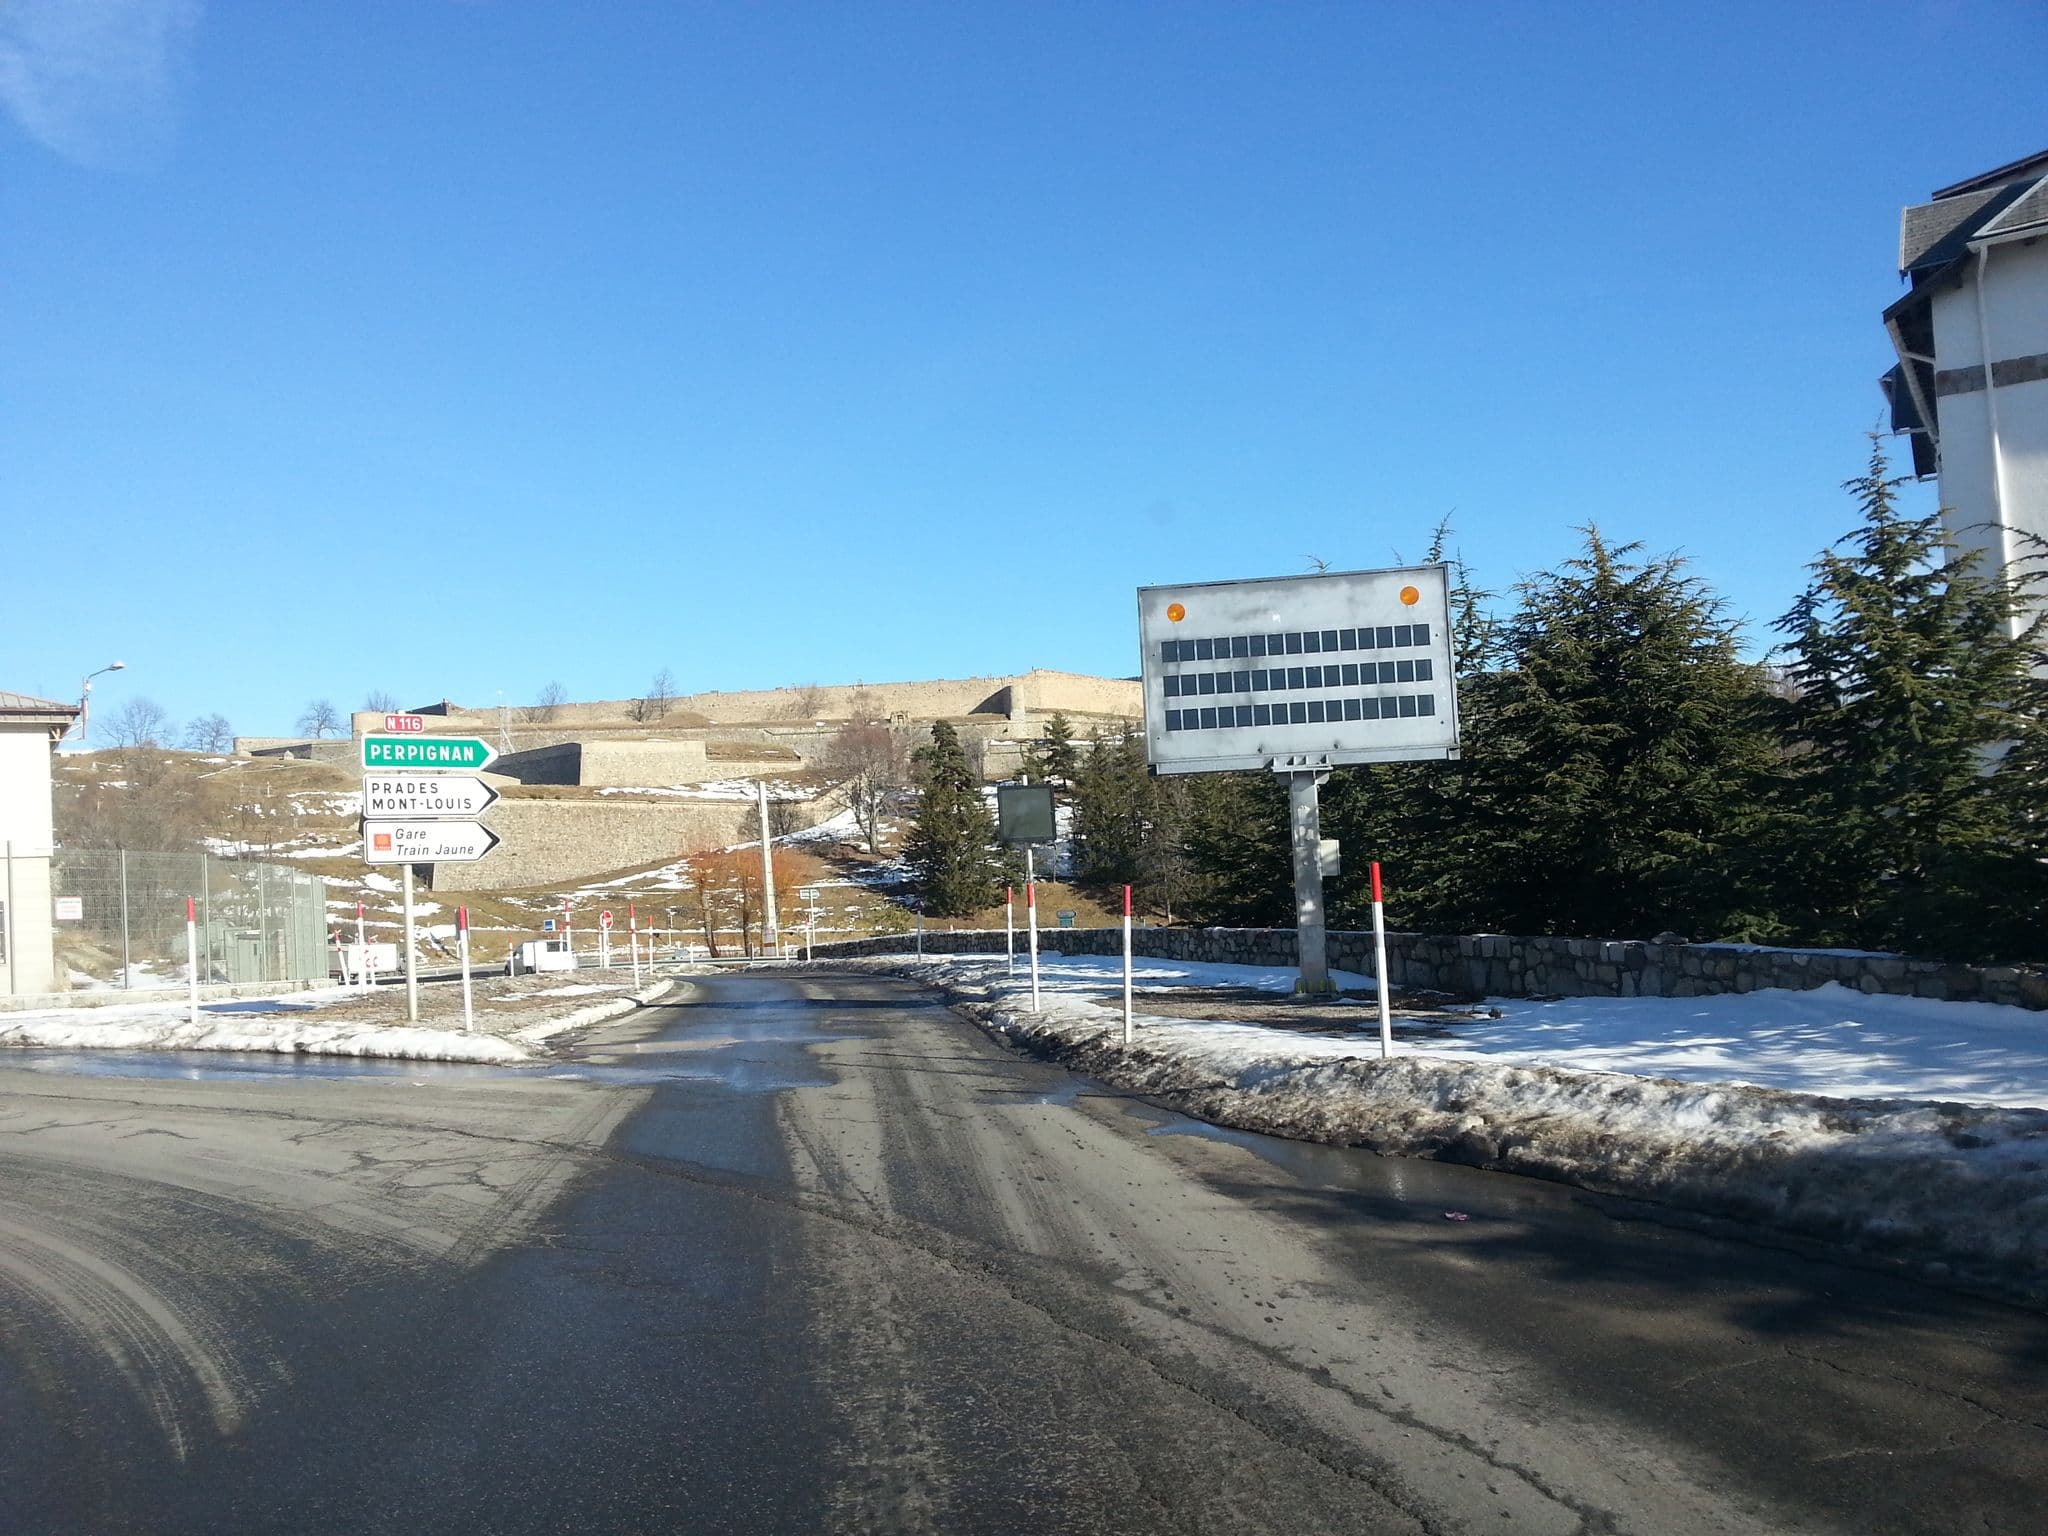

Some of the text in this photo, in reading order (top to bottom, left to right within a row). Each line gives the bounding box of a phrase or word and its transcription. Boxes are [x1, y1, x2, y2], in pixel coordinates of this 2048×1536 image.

[387, 717, 421, 730] N 116
[370, 744, 474, 762] PERPIGNAN
[372, 782, 439, 794] PRADES
[372, 798, 472, 810] MONT-LOUIS
[395, 828, 427, 840] Gare
[396, 844, 475, 856] Train Jaune
